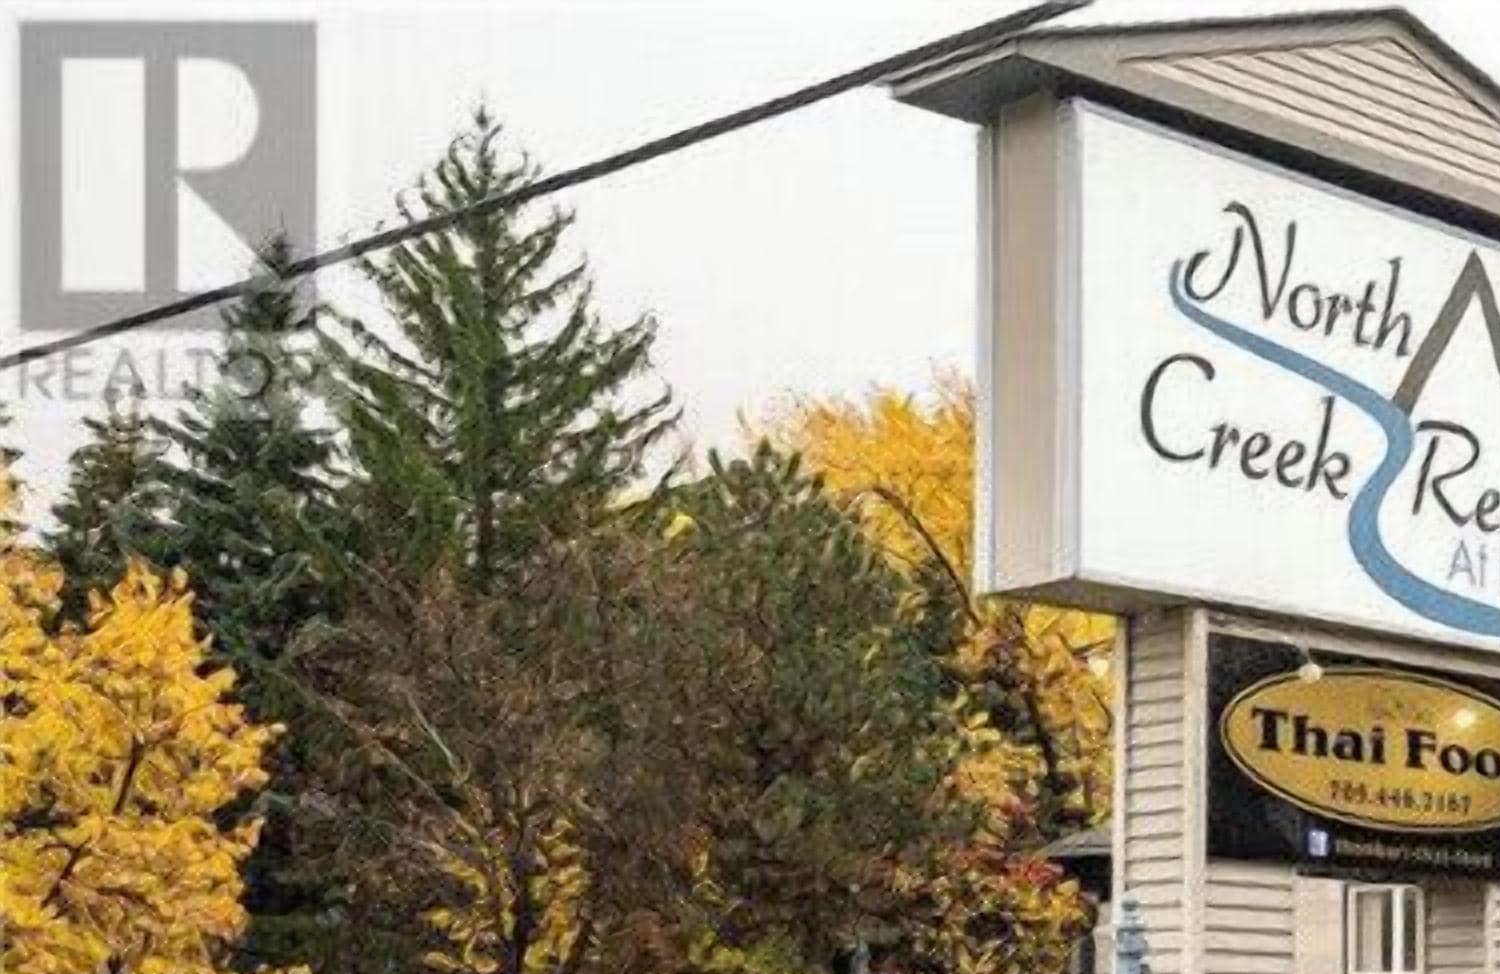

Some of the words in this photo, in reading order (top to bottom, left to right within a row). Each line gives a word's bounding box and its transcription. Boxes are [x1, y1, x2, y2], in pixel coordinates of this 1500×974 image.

[1184, 200, 1413, 357] North
[1139, 353, 1354, 501] Creek
[1447, 539, 1487, 586] At
[1251, 707, 1386, 765] Thai
